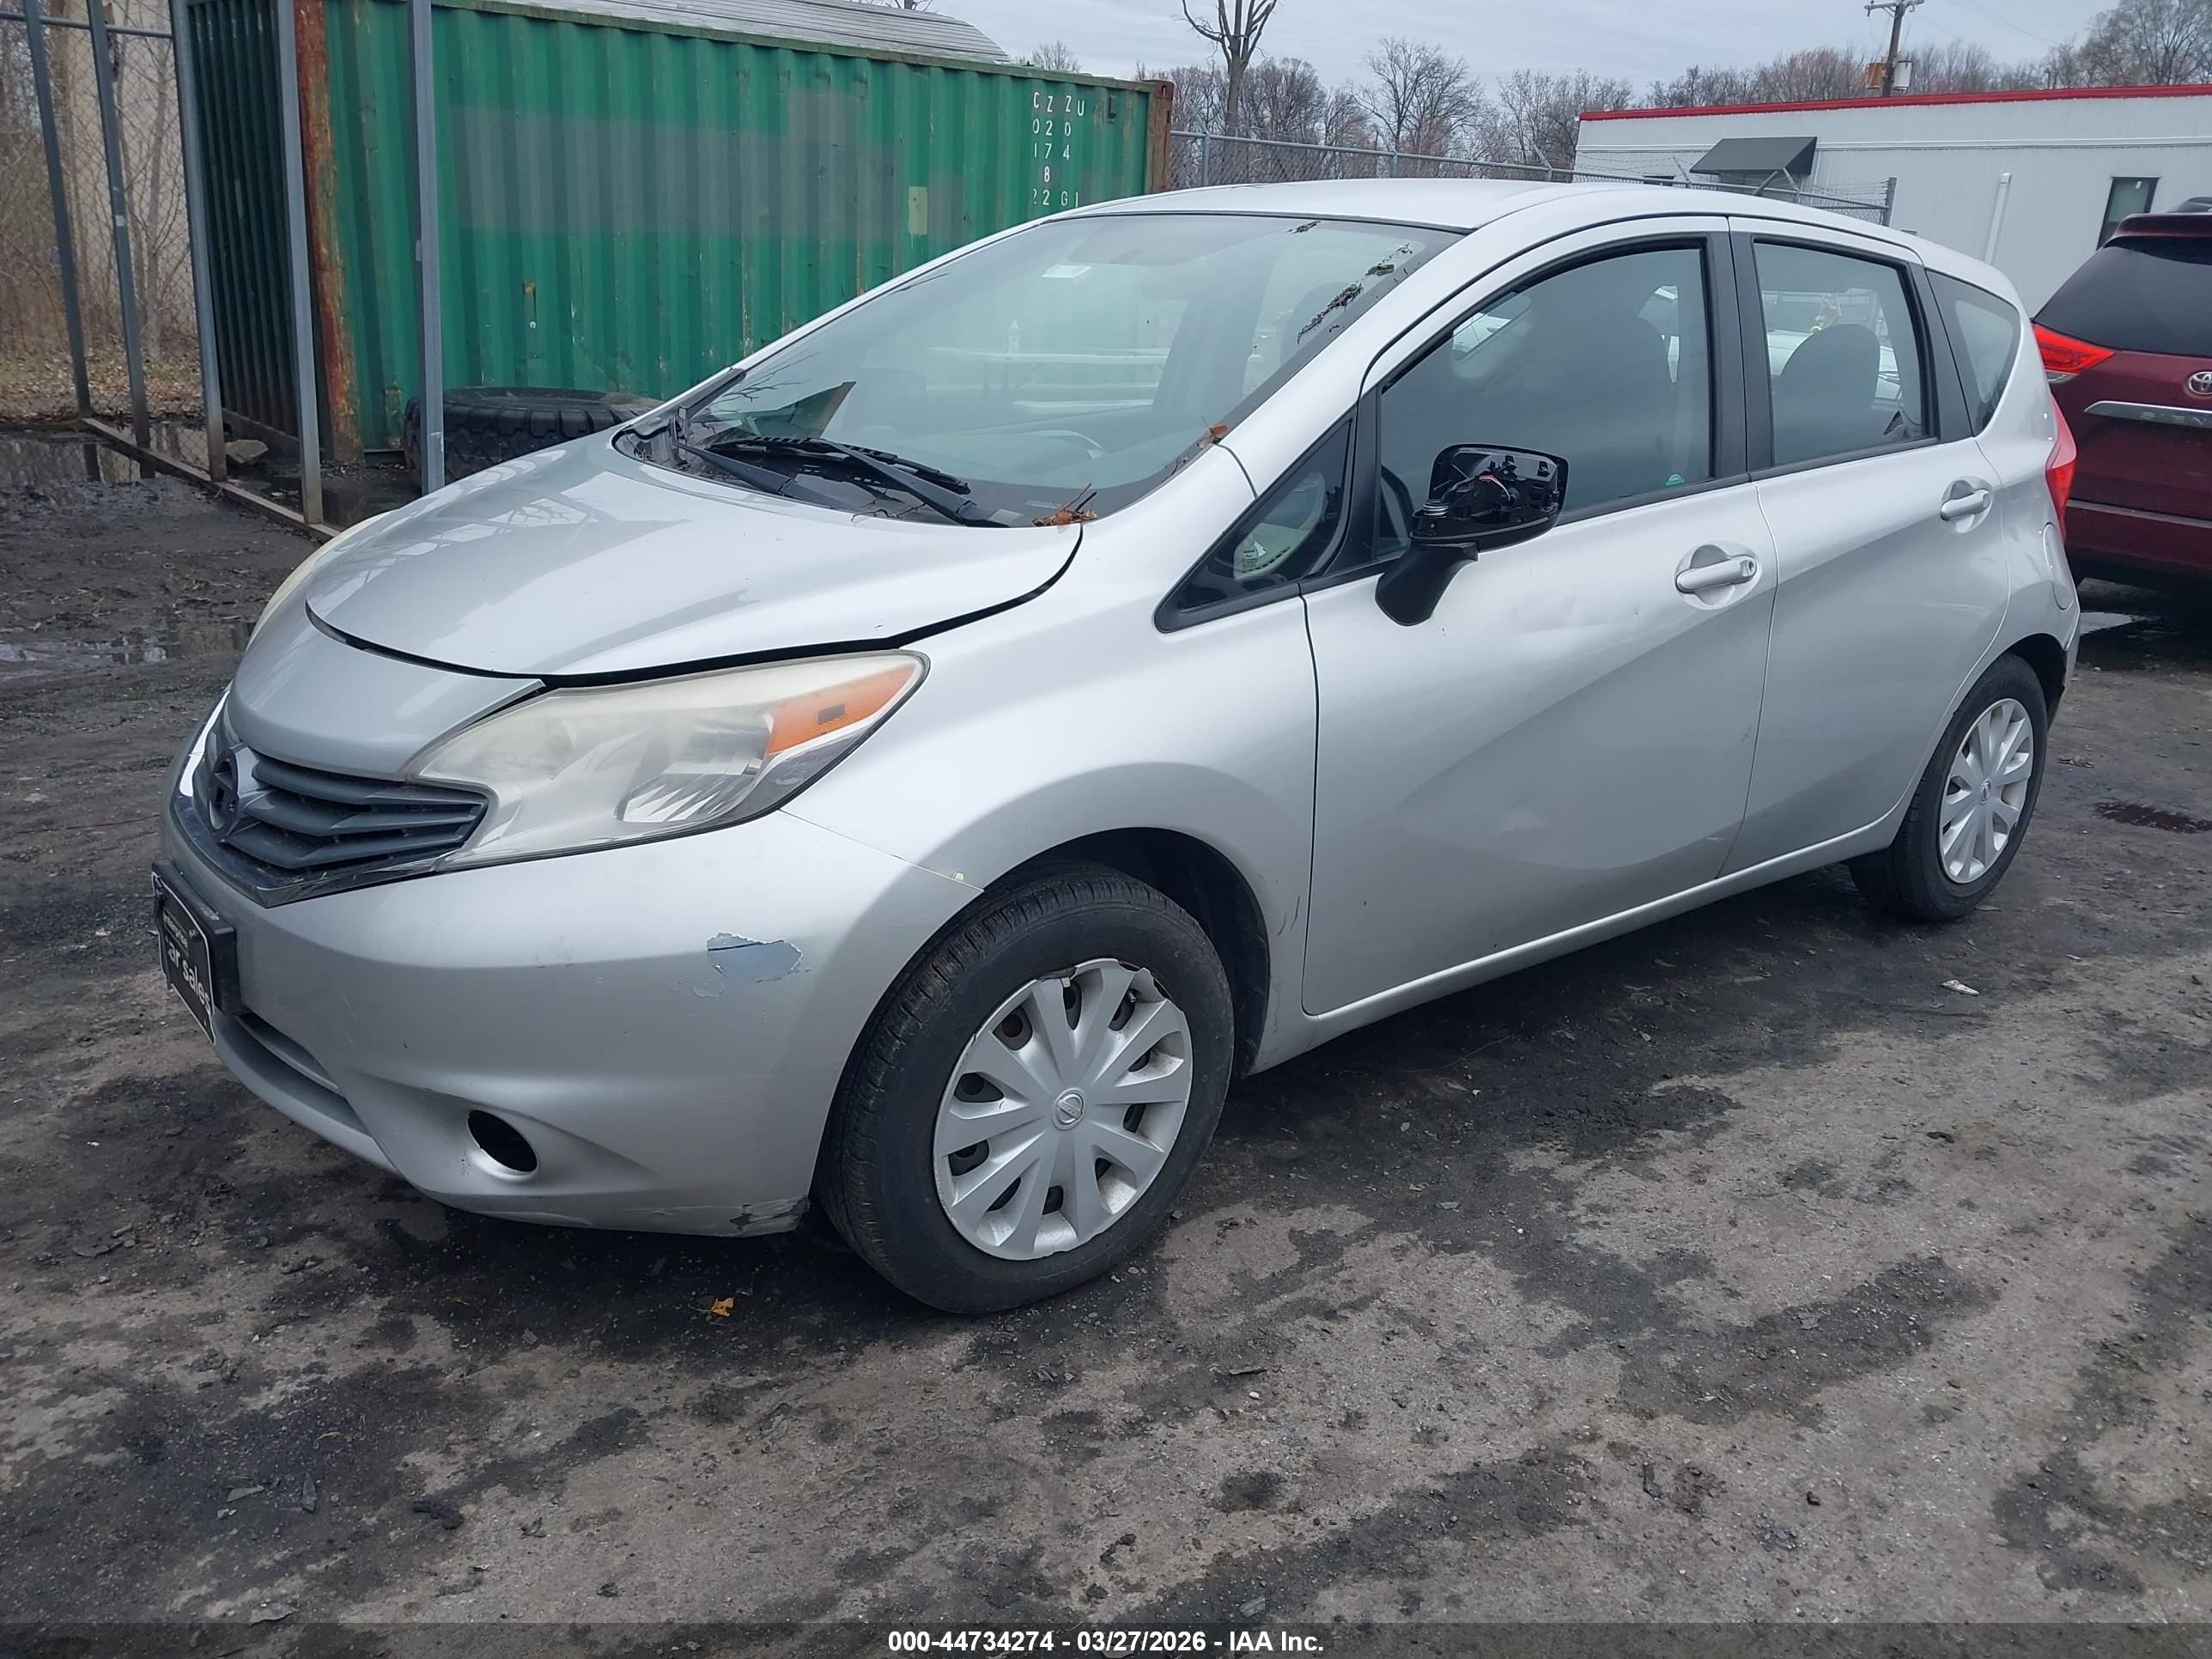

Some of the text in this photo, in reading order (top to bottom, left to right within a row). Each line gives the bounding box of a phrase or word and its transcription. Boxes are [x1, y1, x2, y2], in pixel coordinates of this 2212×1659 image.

[1033, 91, 1085, 117] CZZU
[1043, 166, 1051, 183] 8
[182, 959, 211, 1016] sales
